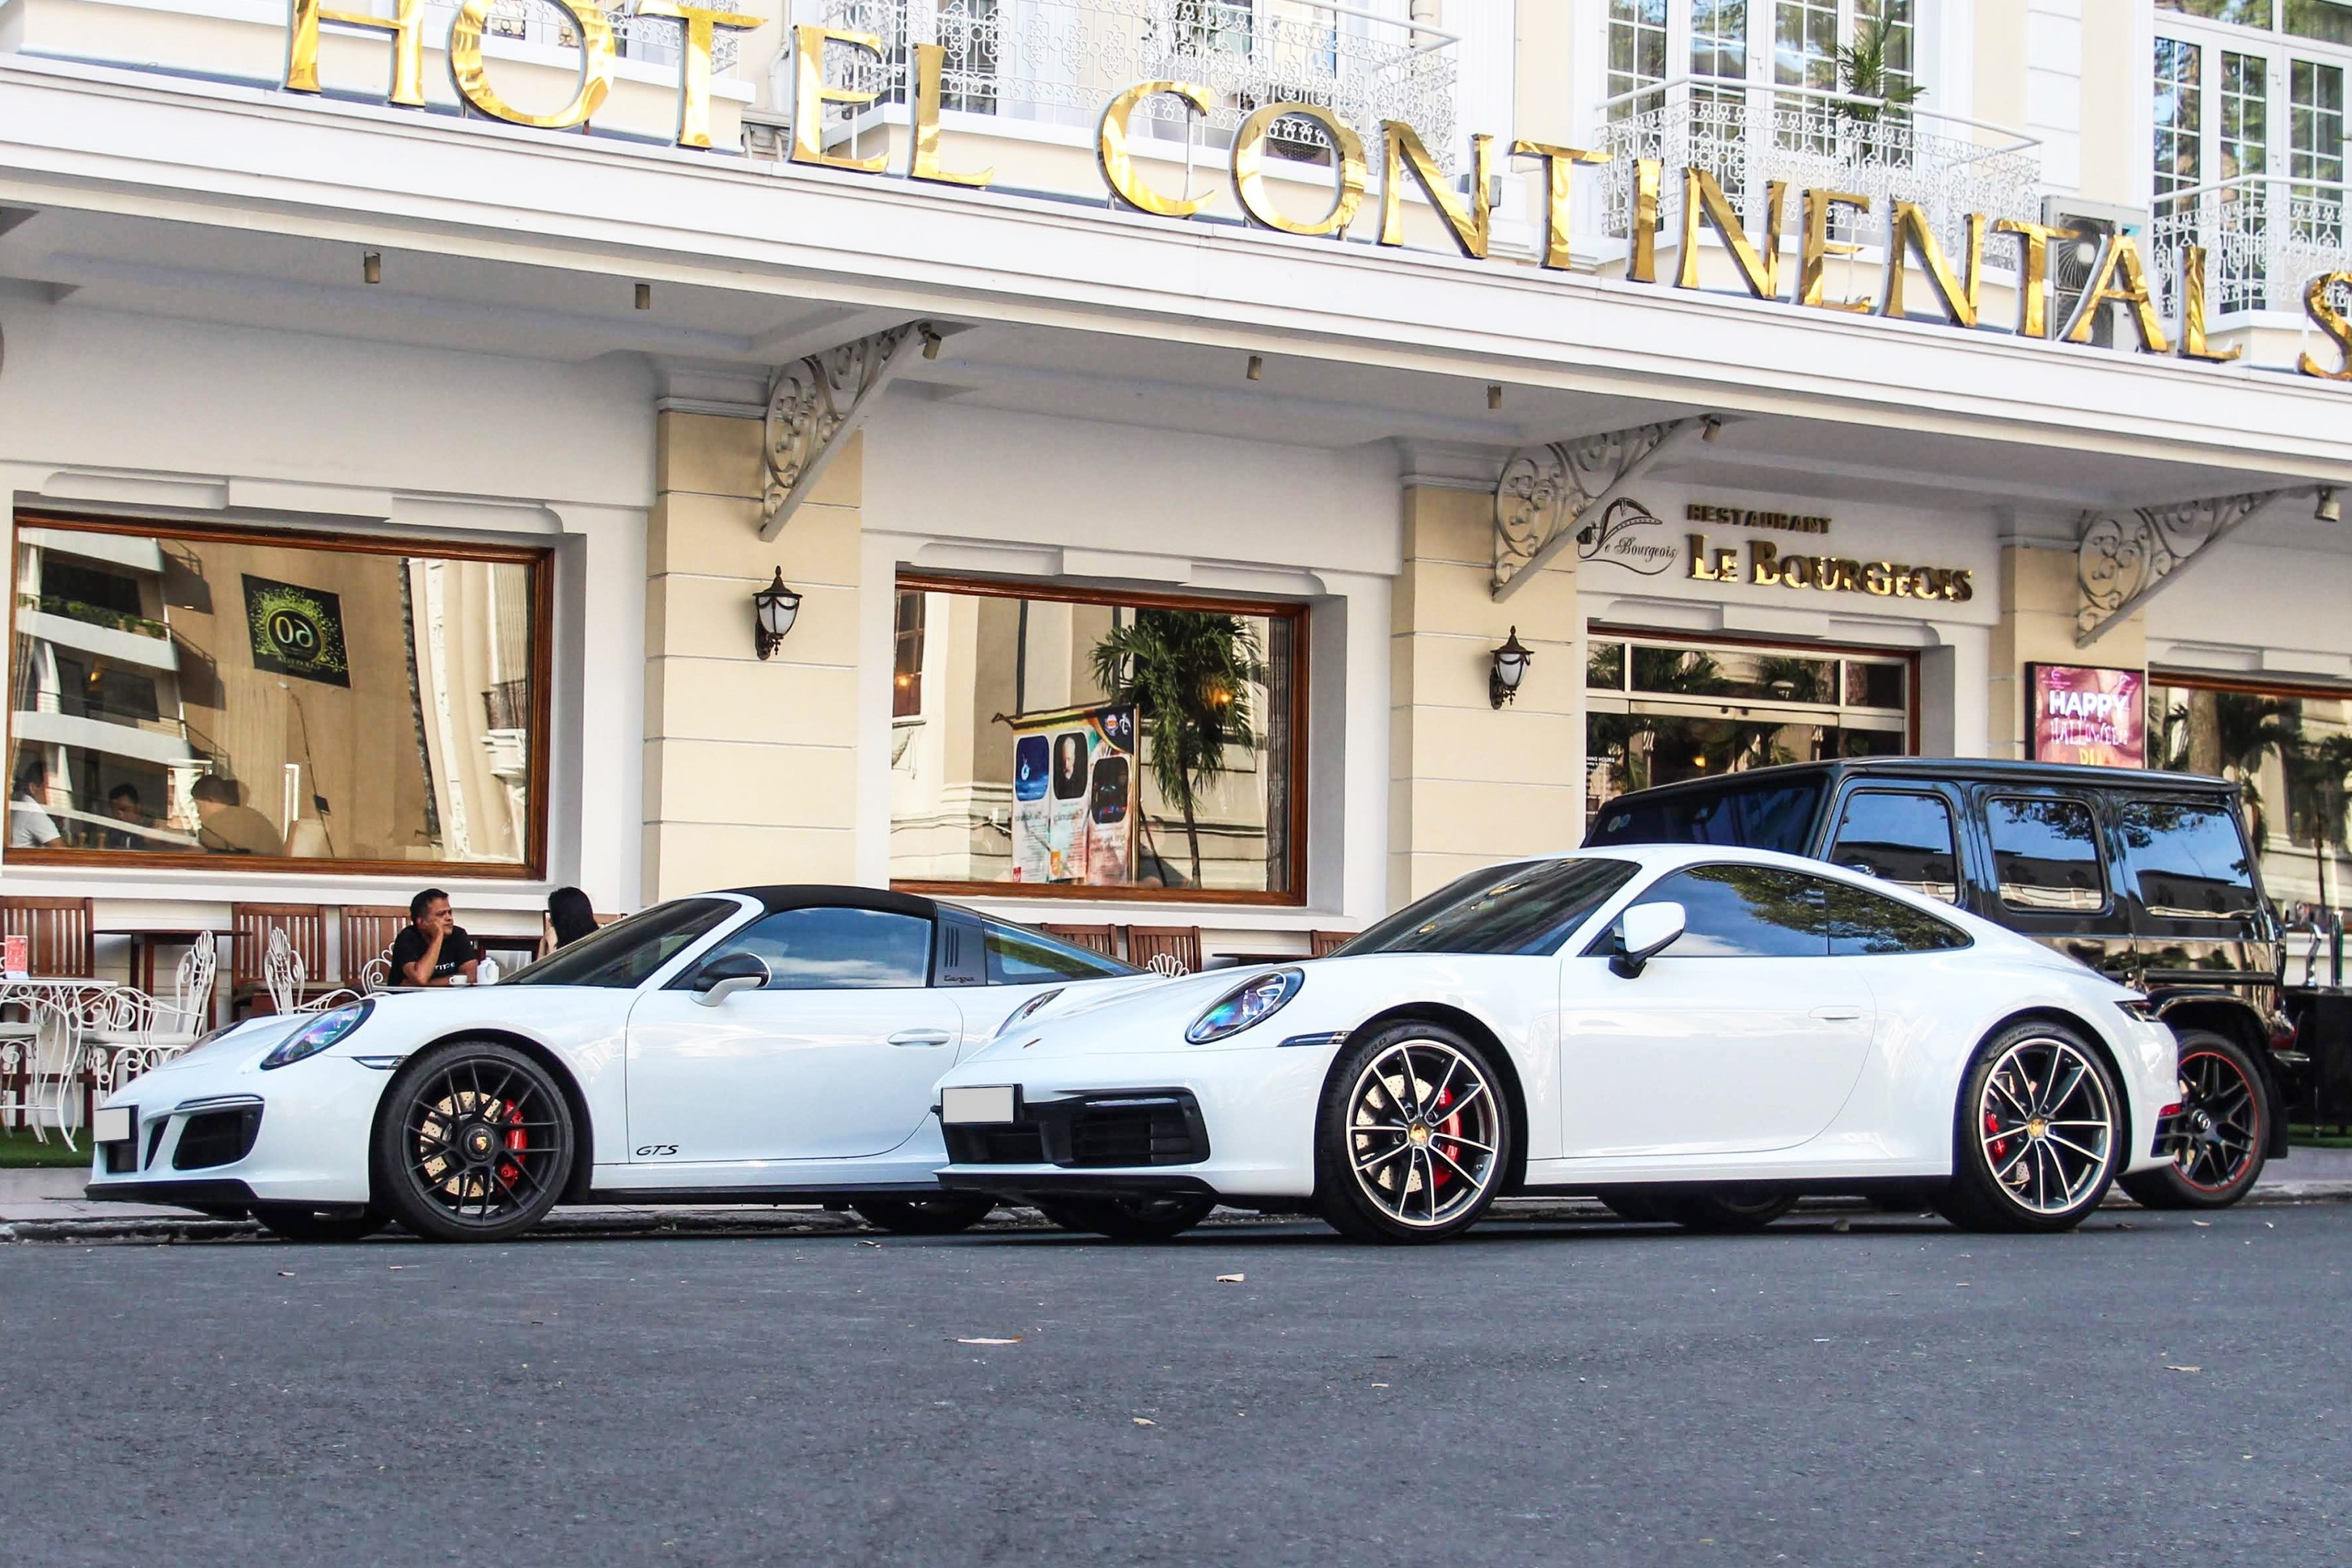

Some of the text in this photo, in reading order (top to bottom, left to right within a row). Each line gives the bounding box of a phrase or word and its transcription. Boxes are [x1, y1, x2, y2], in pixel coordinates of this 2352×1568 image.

[284, 0, 994, 187] HOTEL
[1096, 79, 2242, 361] CONTINENTAL
[1686, 504, 1832, 534] RESTAURANT
[1614, 537, 1677, 562] Bourgeois
[2049, 690, 2129, 722] HAPPY
[2049, 717, 2129, 745] HALLOWEEN
[636, 1145, 679, 1156] GTS
